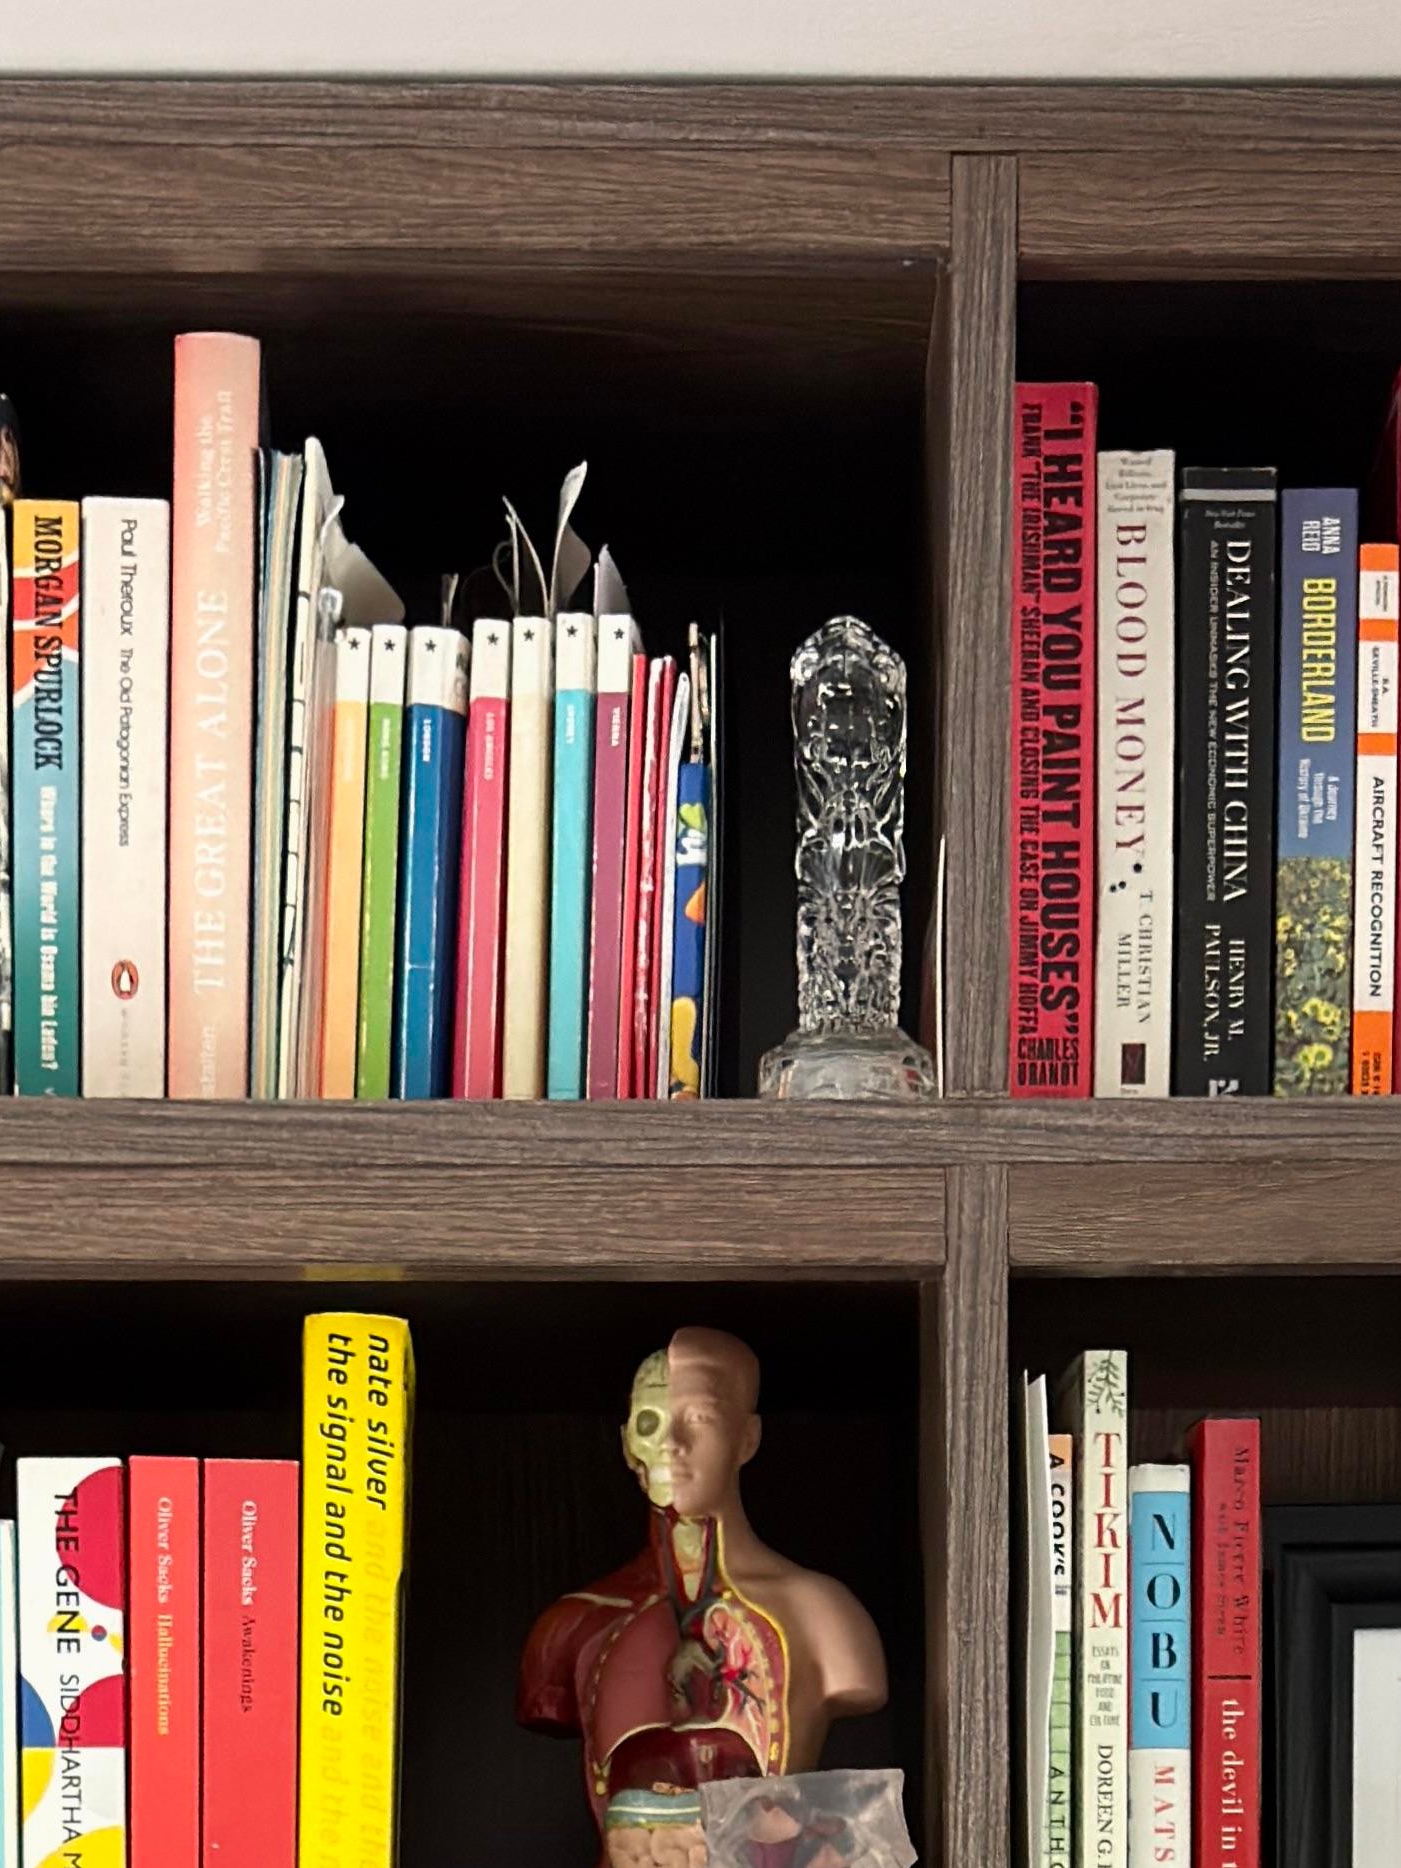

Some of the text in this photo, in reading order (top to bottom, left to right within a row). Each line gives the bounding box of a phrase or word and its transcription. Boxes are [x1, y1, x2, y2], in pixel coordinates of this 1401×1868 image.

[34, 516, 64, 771] MORGAN SPURLOCK
[118, 518, 137, 637] Paul Theroux
[1115, 523, 1149, 679] BLOOD
[1301, 577, 1337, 744] BORDERLAND
[1114, 698, 1146, 856] MONEY
[1369, 776, 1387, 998] AIRCRAFT RECOGNITION
[365, 1335, 391, 1511] nate silver
[55, 1491, 78, 1549] THE
[320, 1333, 350, 1716] the signal and the noise
[56, 1565, 81, 1655] GENE
[59, 1673, 83, 1845] SIDDHARTHA
[1221, 1698, 1245, 1741] the
[1221, 1749, 1245, 1815] devil
[1221, 1826, 1243, 1851] in
